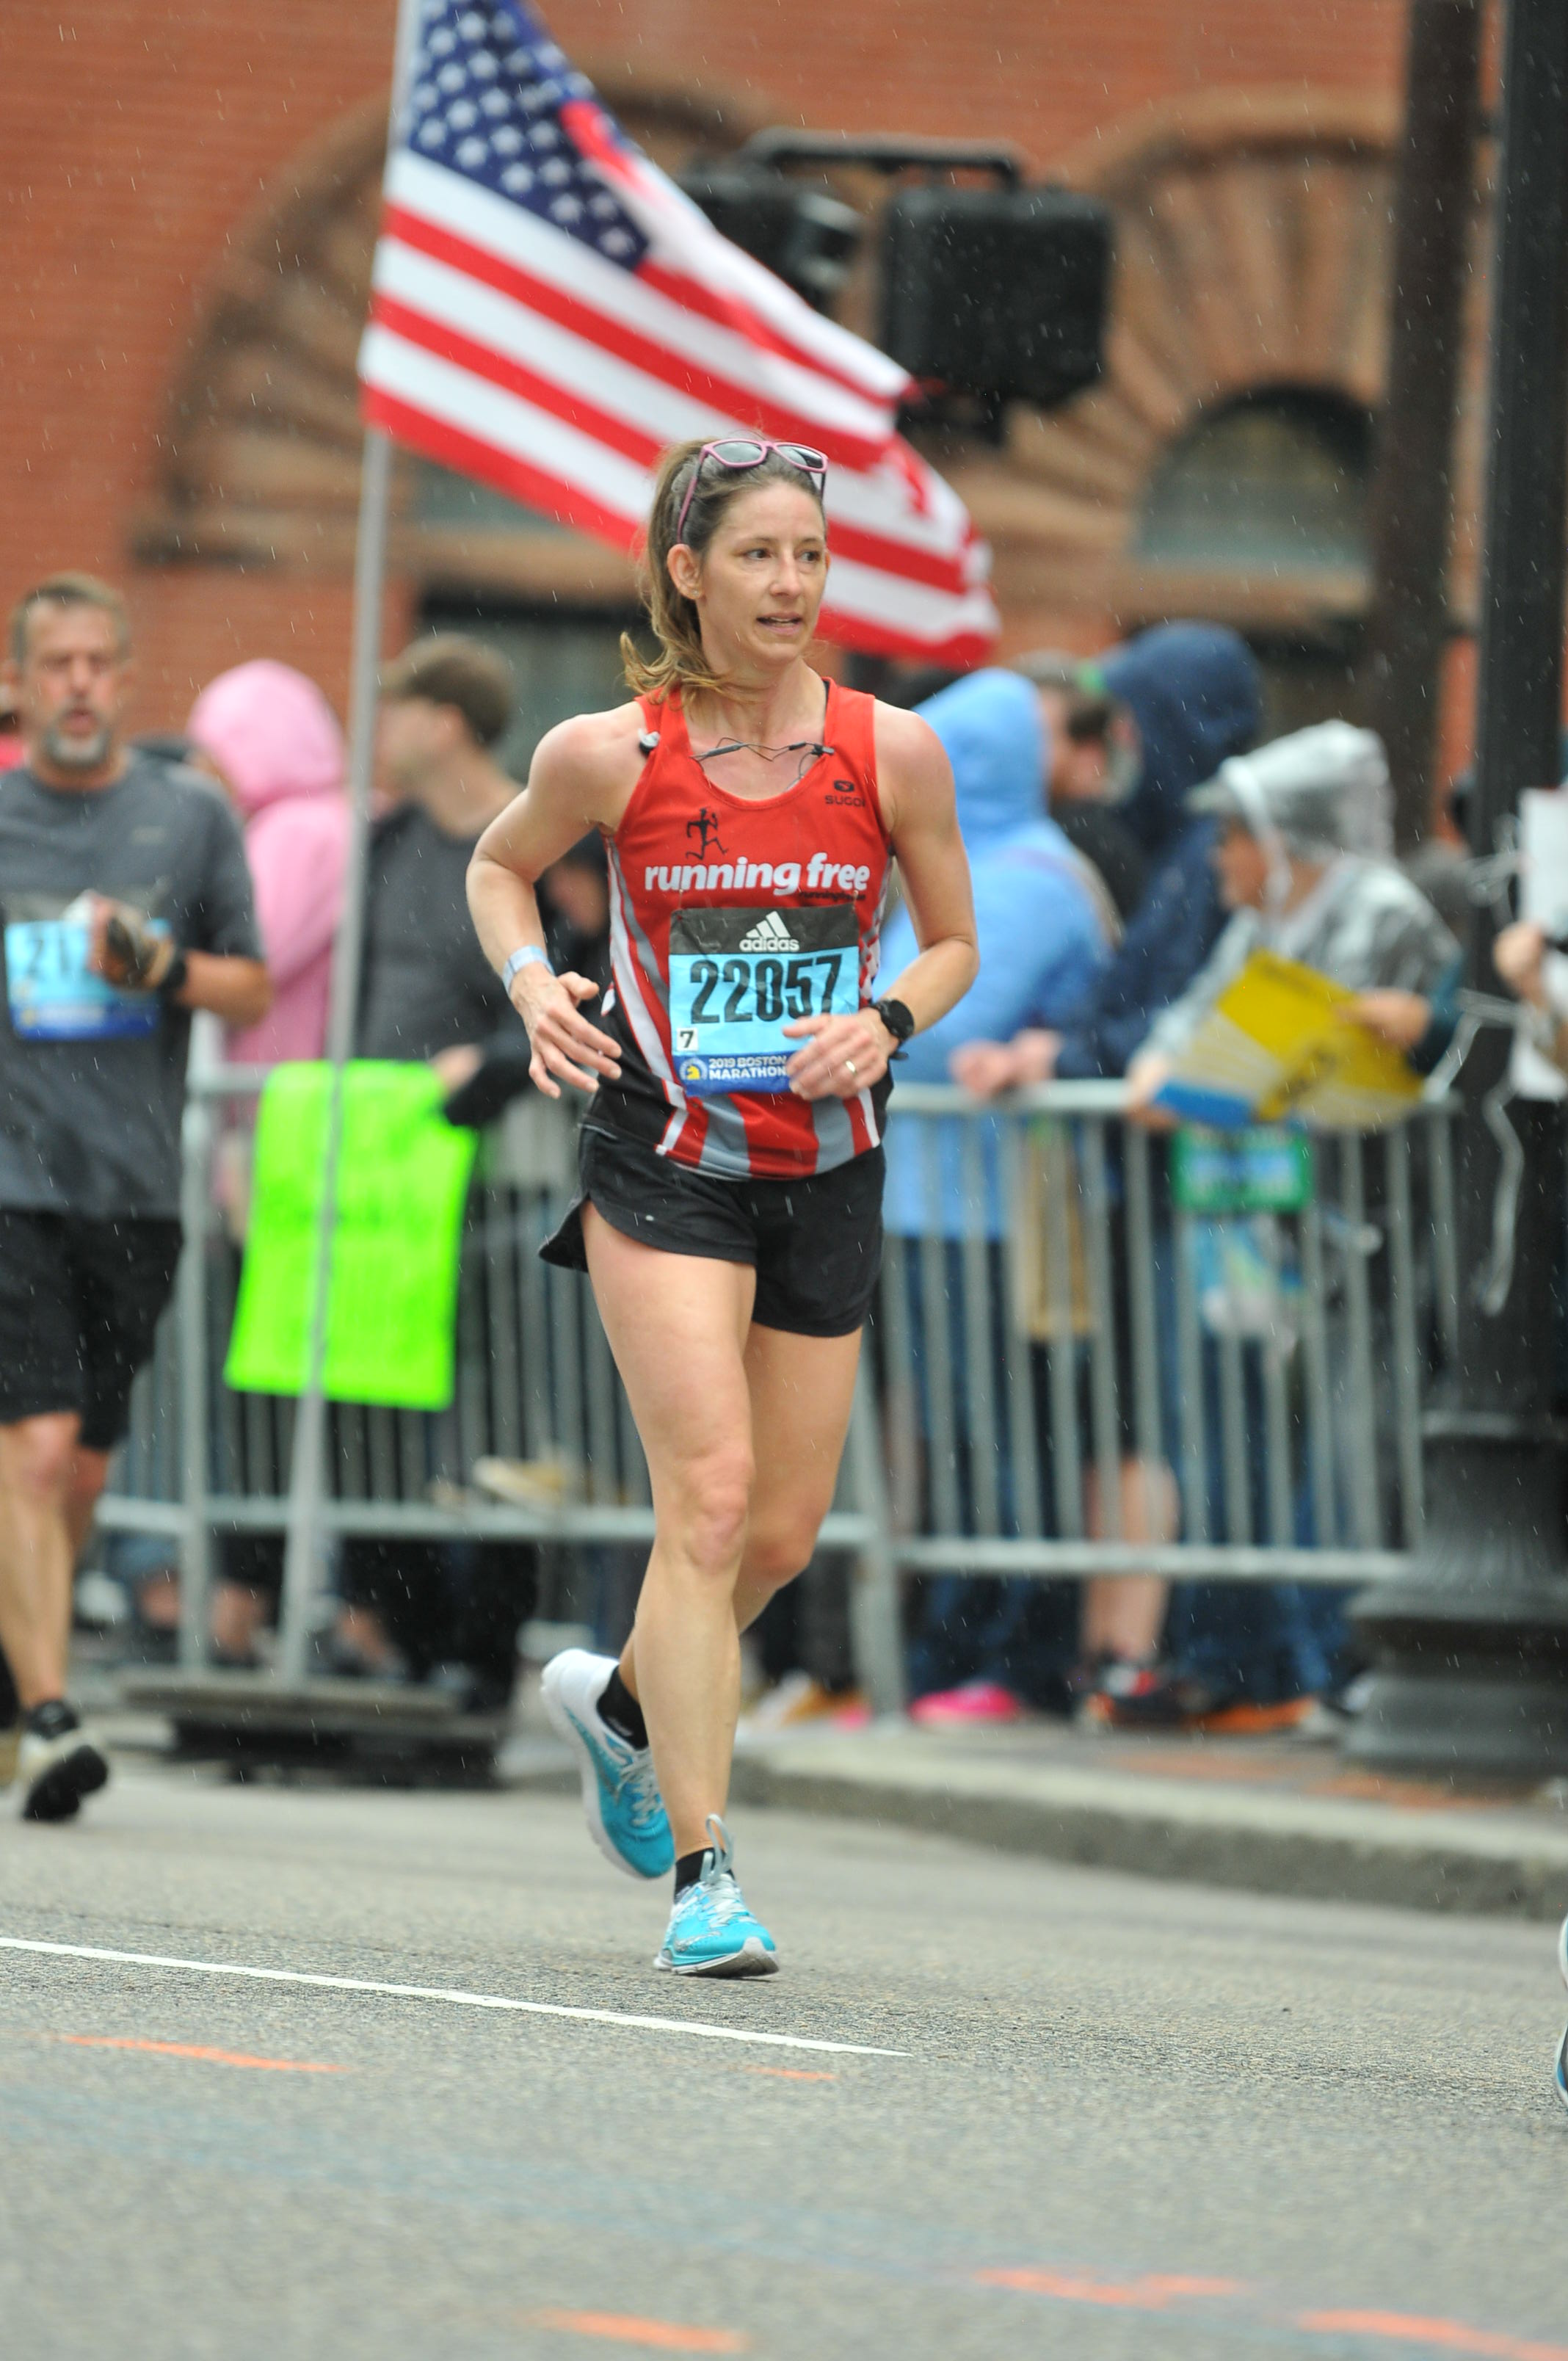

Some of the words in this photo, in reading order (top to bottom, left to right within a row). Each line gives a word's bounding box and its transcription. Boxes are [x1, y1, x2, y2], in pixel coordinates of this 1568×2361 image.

[645, 857, 802, 896] running
[807, 852, 871, 891] free
[739, 937, 799, 953] adidas
[690, 954, 843, 1024] 22057
[680, 1030, 694, 1048] 7
[708, 1058, 736, 1069] 2019
[737, 1055, 788, 1067] BOSTON
[708, 1065, 788, 1080] MARATHON
